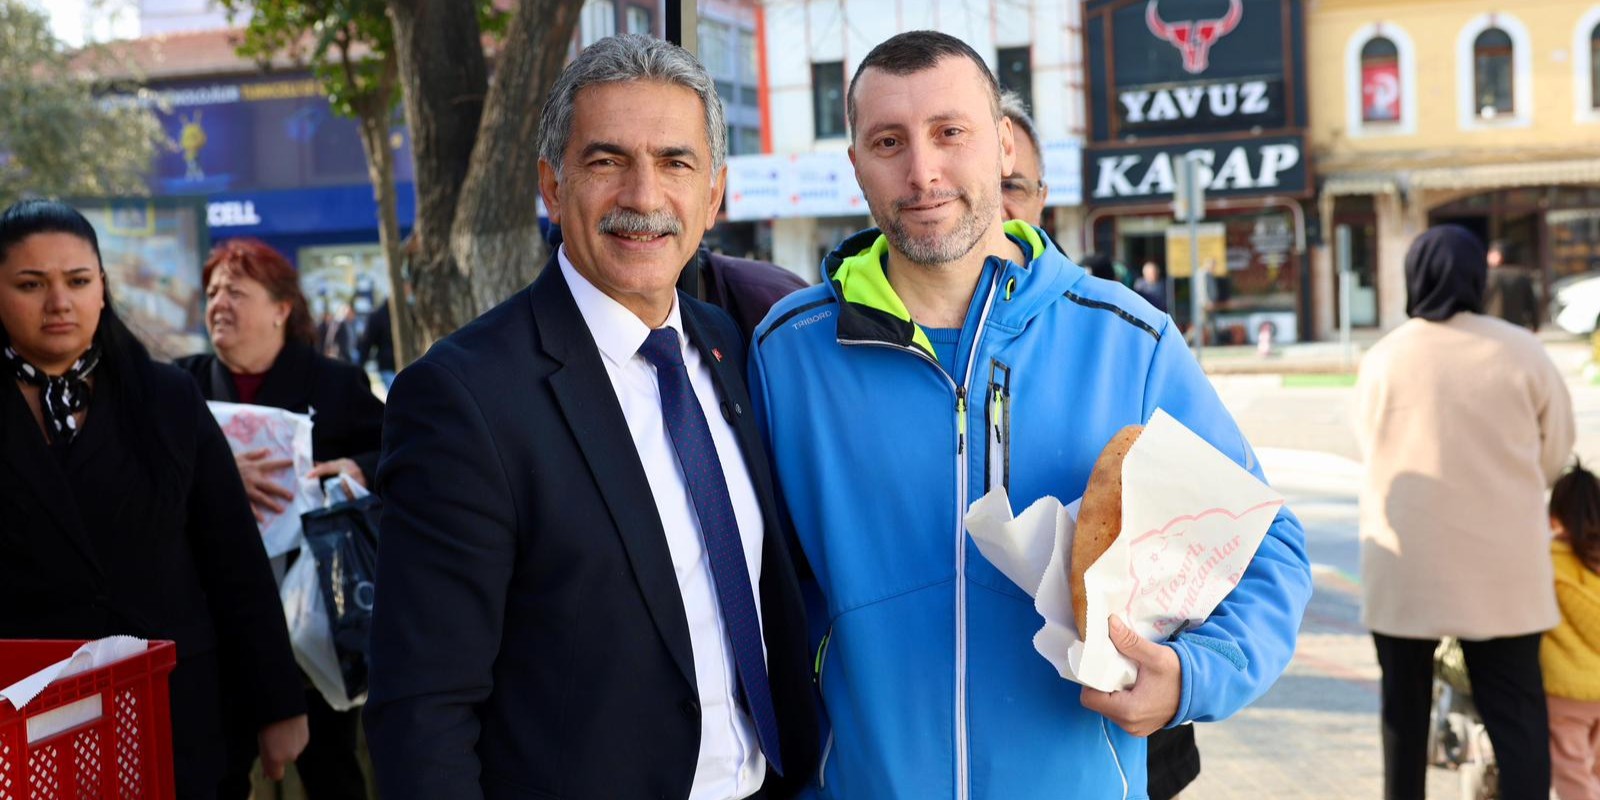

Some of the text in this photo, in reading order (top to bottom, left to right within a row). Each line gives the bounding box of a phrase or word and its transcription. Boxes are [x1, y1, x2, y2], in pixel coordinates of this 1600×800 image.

[1119, 81, 1270, 123] YAVUZ
[1093, 143, 1299, 198] KASAP
[792, 310, 832, 330] TRIBORD
